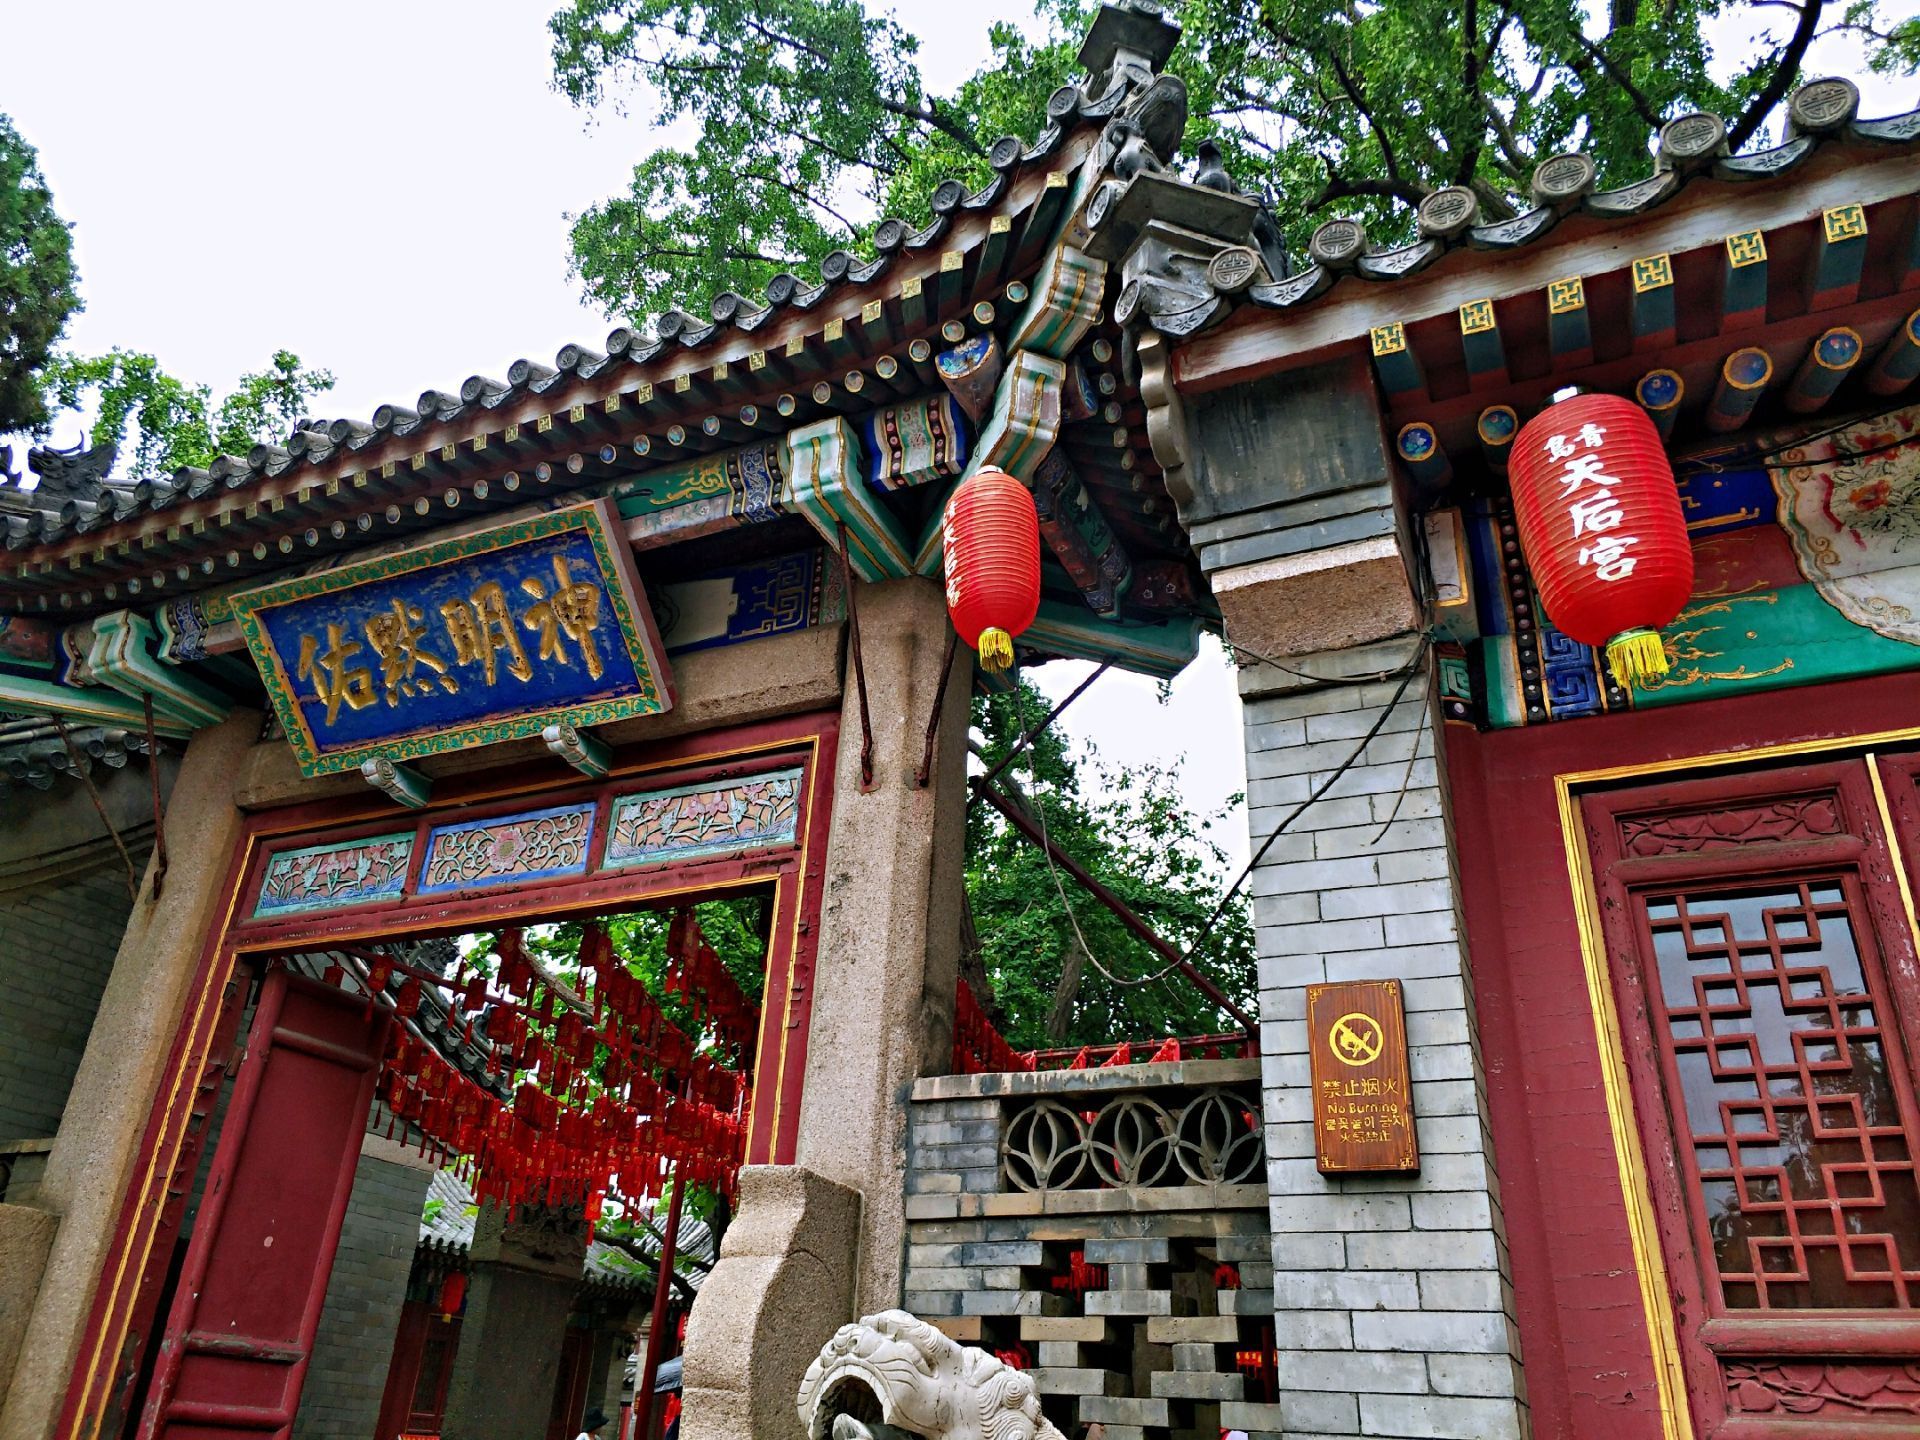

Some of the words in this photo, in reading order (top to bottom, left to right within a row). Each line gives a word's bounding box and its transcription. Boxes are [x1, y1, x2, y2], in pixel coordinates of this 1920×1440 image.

[1322, 1077, 1399, 1099] 禁止烟火
[1327, 1102, 1346, 1114] No
[1349, 1102, 1398, 1114] Burning
